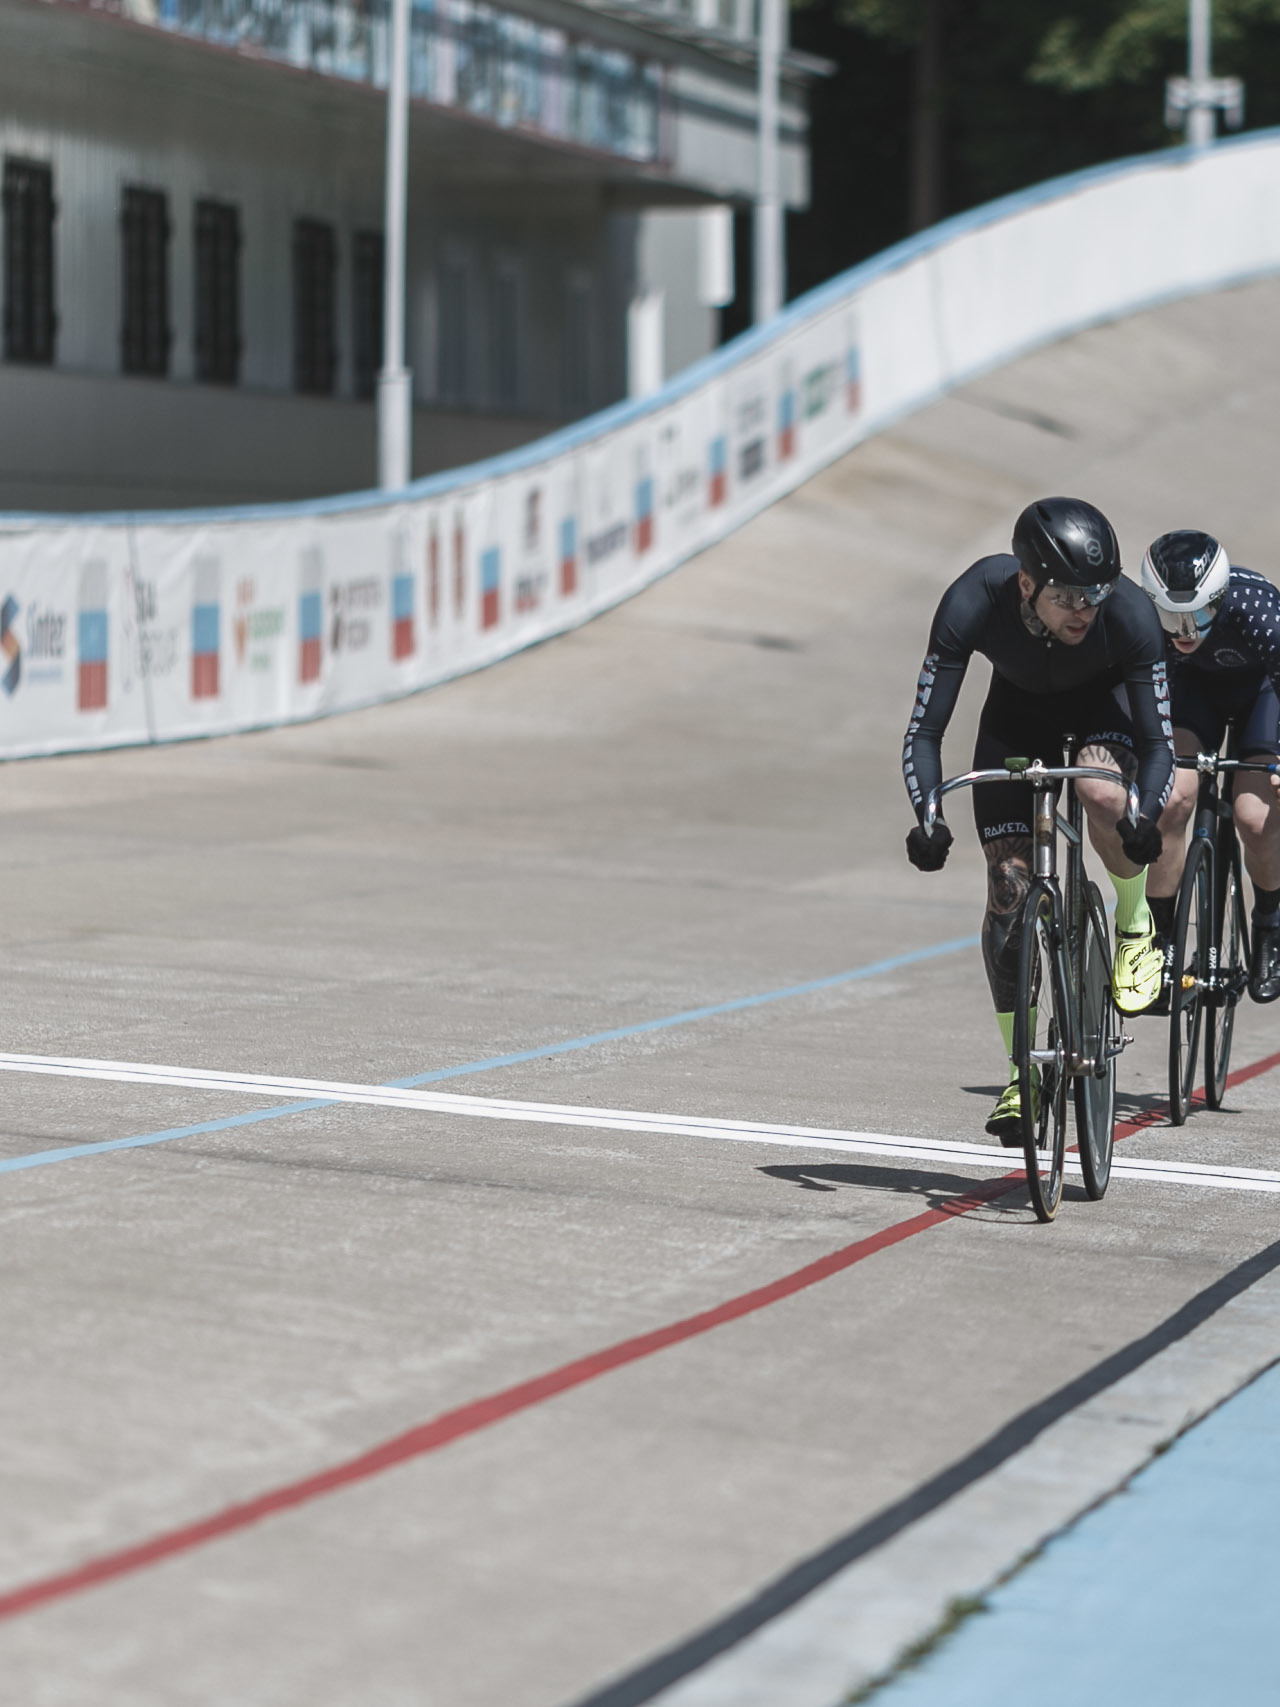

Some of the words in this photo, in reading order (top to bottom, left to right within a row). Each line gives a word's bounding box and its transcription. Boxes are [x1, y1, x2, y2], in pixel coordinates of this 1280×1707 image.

[1084, 731, 1134, 747] RAKETA
[984, 822, 1030, 839] RAKETA
[1129, 946, 1147, 966] BONT
